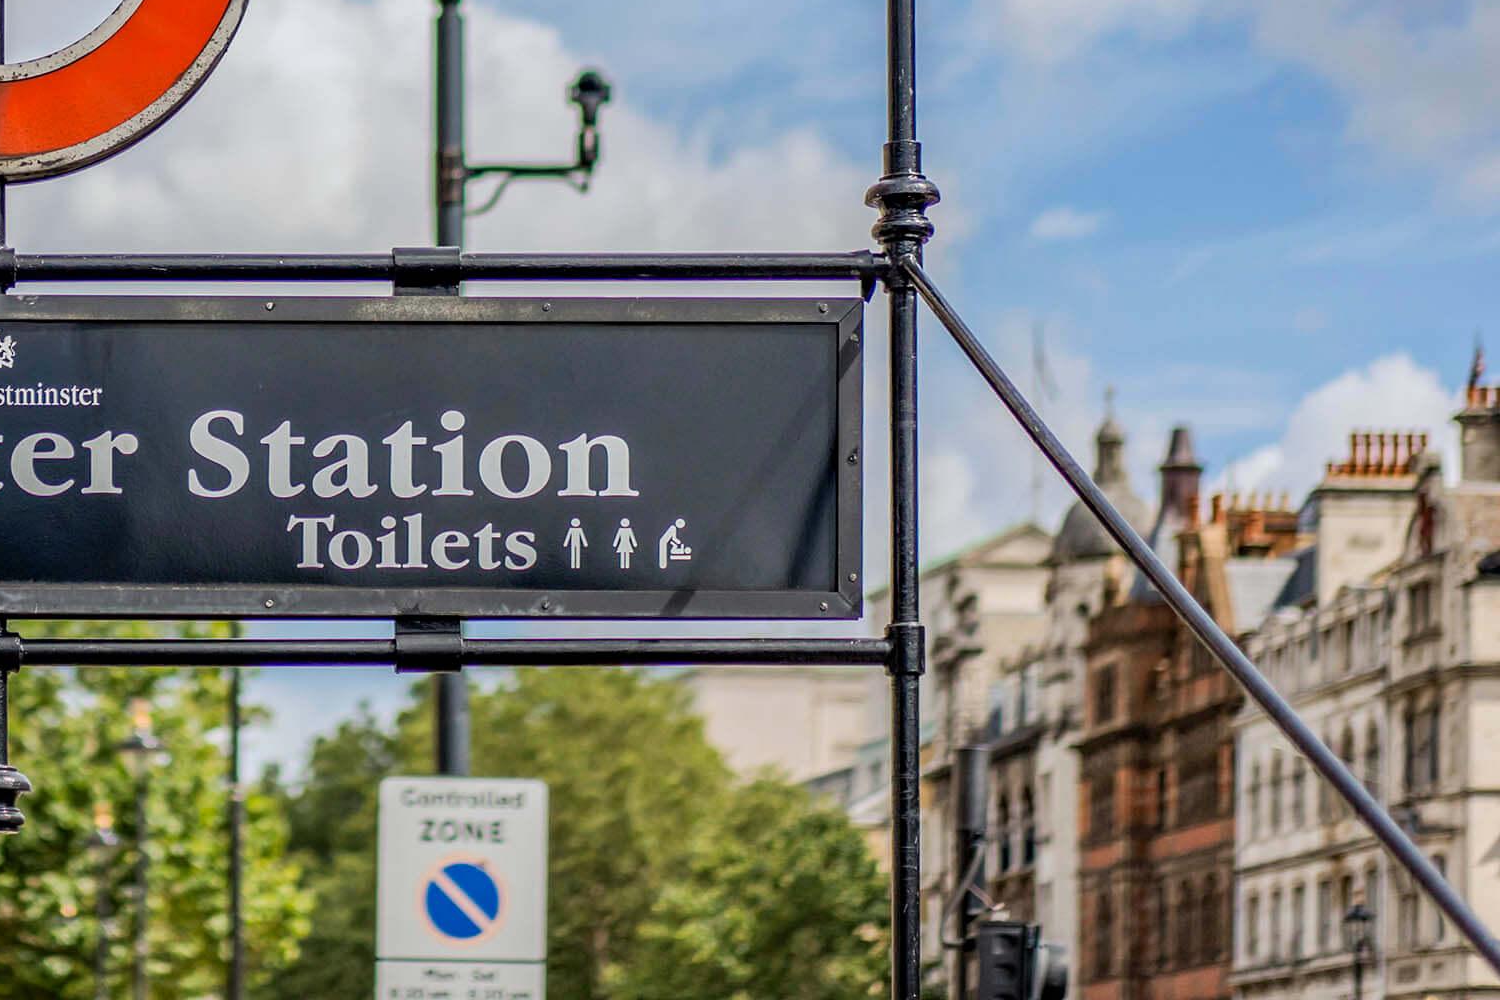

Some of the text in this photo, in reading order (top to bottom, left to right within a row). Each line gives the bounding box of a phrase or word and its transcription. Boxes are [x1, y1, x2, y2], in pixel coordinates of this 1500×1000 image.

[188, 408, 640, 499] Station
[286, 512, 537, 570] Toilets
[401, 787, 525, 808] Controlled
[419, 818, 504, 843] ZONE
